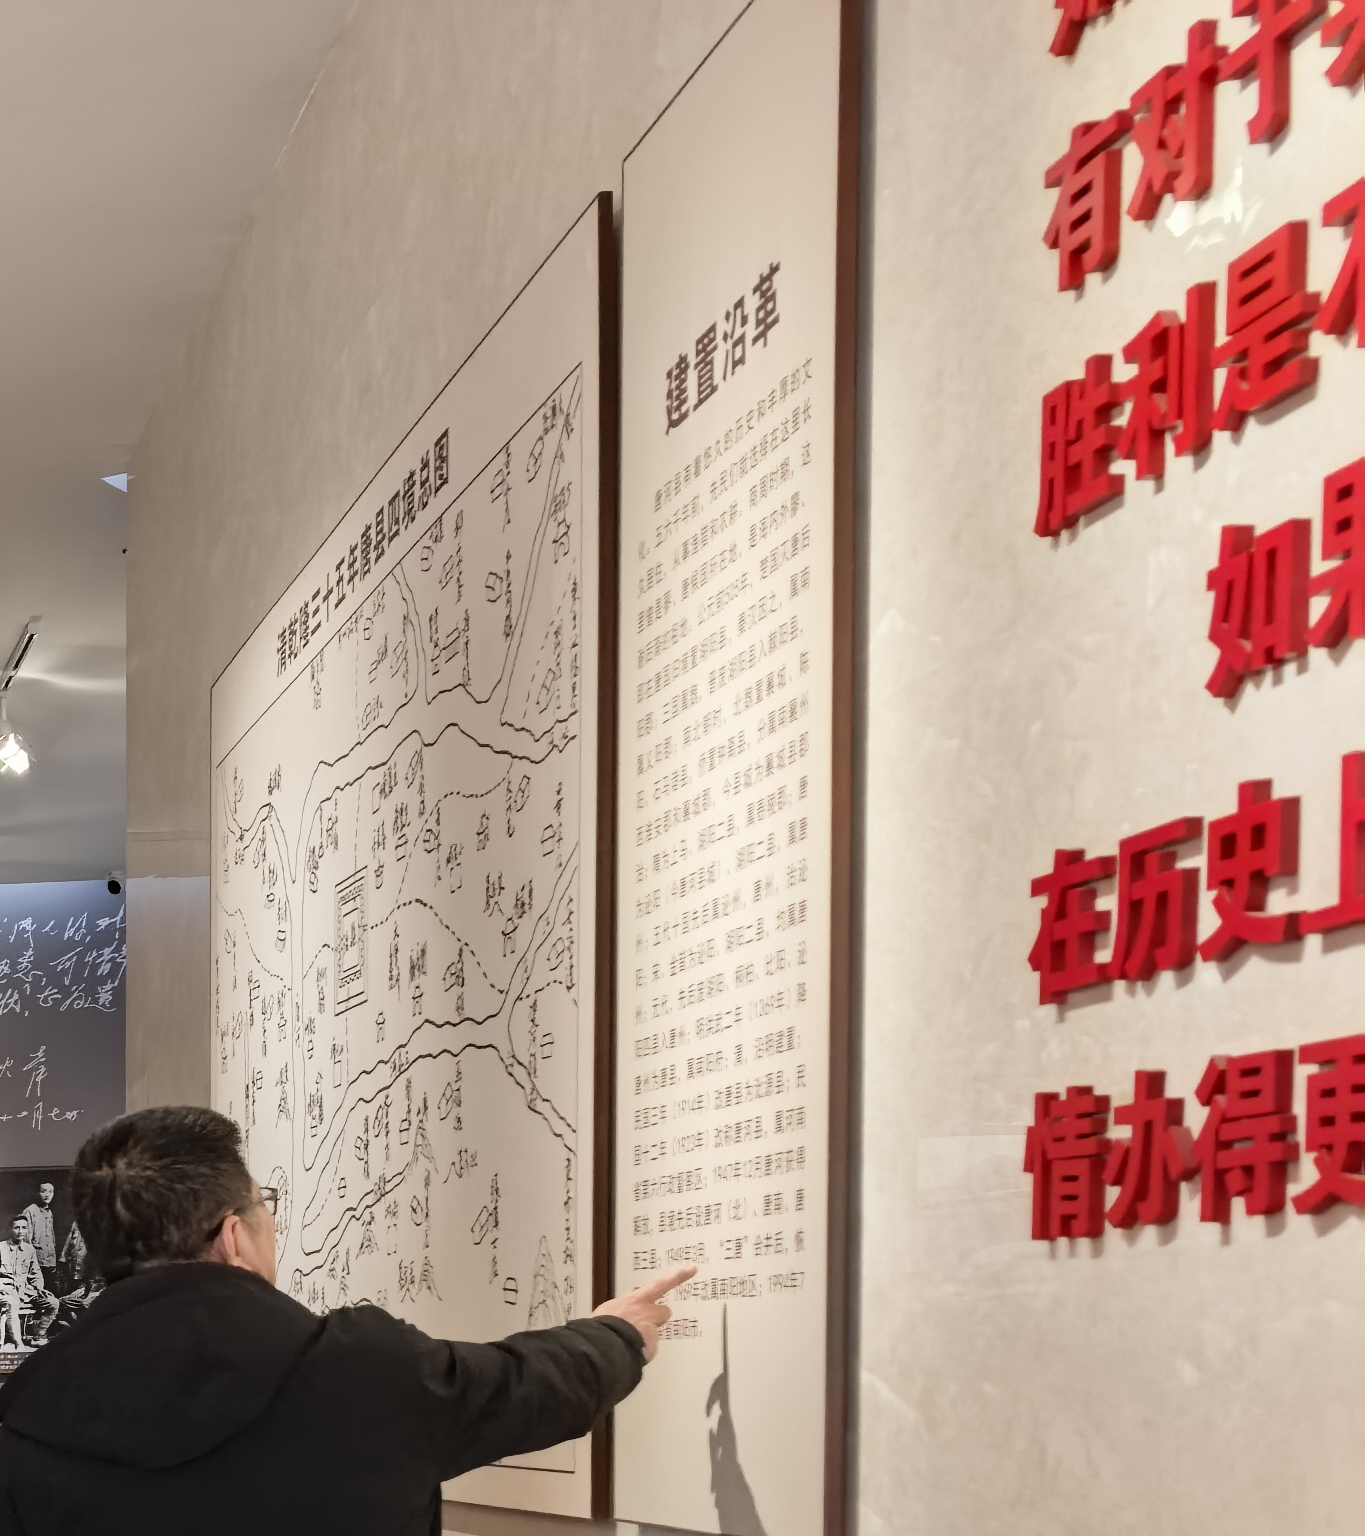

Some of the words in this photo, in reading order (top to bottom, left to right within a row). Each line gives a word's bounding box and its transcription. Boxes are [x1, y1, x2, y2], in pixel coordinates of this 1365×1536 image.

[665, 260, 782, 436] 建置沿革
[277, 427, 451, 679] 清乾隆三十五年唐县四境总图
[1024, 1033, 1365, 1241] 情办得更
